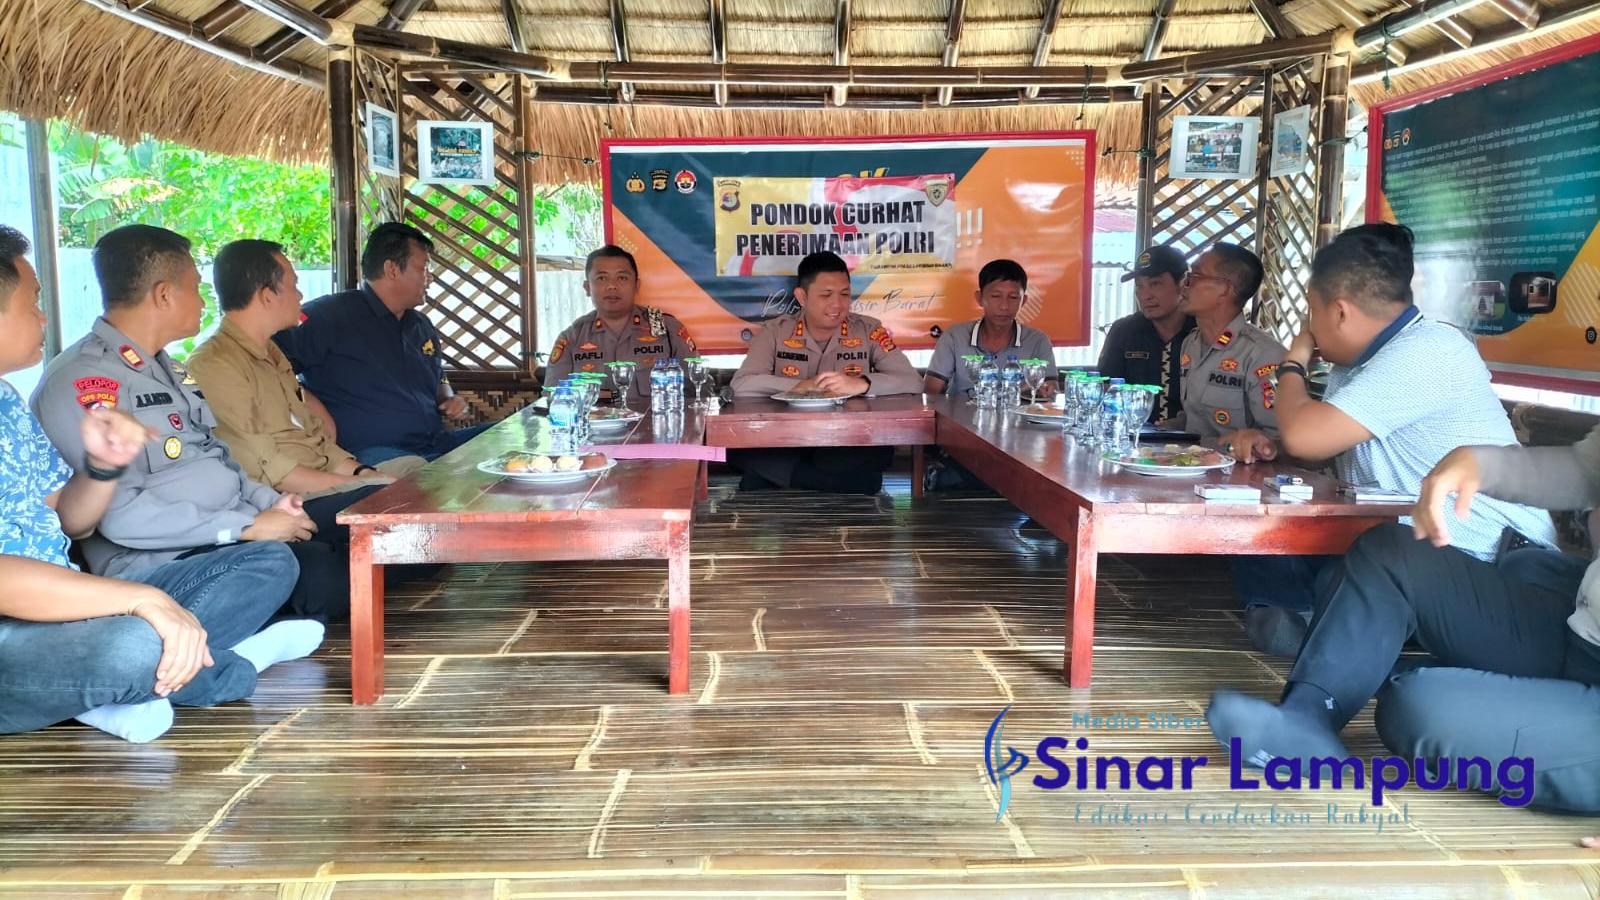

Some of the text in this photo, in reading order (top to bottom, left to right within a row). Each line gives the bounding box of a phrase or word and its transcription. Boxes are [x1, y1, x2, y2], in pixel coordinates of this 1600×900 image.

[750, 200, 926, 226] PONDOK CURHAT
[736, 231, 935, 256] PENERIMAAN POLRI
[760, 288, 801, 318] Polr
[882, 288, 945, 313] Barat
[574, 352, 604, 361] RAFLI
[633, 345, 665, 355] POLRI
[836, 351, 868, 361] POLRI
[78, 379, 118, 391] PELOPOR
[1208, 373, 1243, 387] POLRI
